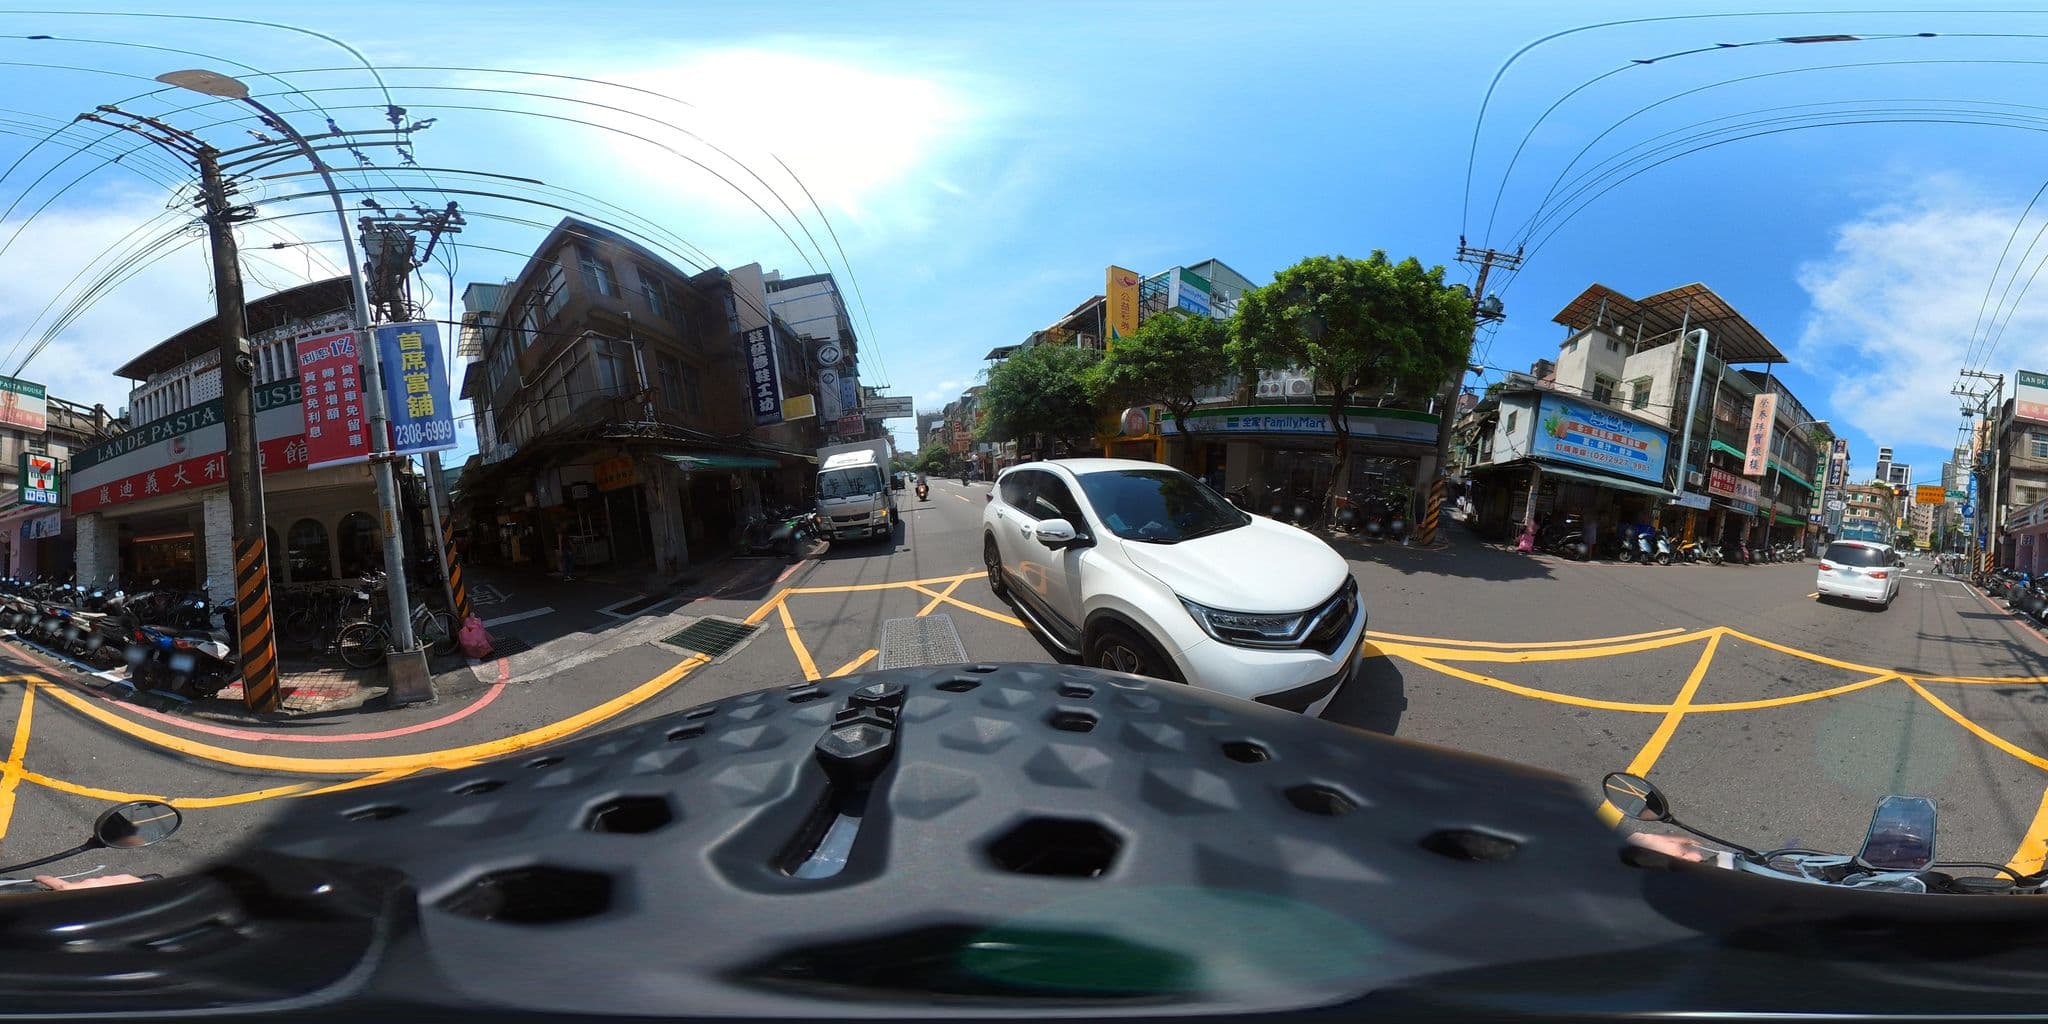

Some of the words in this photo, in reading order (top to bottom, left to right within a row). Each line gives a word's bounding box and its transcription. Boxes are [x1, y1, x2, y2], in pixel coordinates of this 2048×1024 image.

[97, 439, 123, 462] LAN
[127, 431, 146, 450] DE
[151, 407, 216, 441] PASTA
[395, 419, 453, 446] 2308-6999
[1264, 416, 1326, 430] FamilyMart
[99, 438, 309, 506] 嵐迪義大利館
